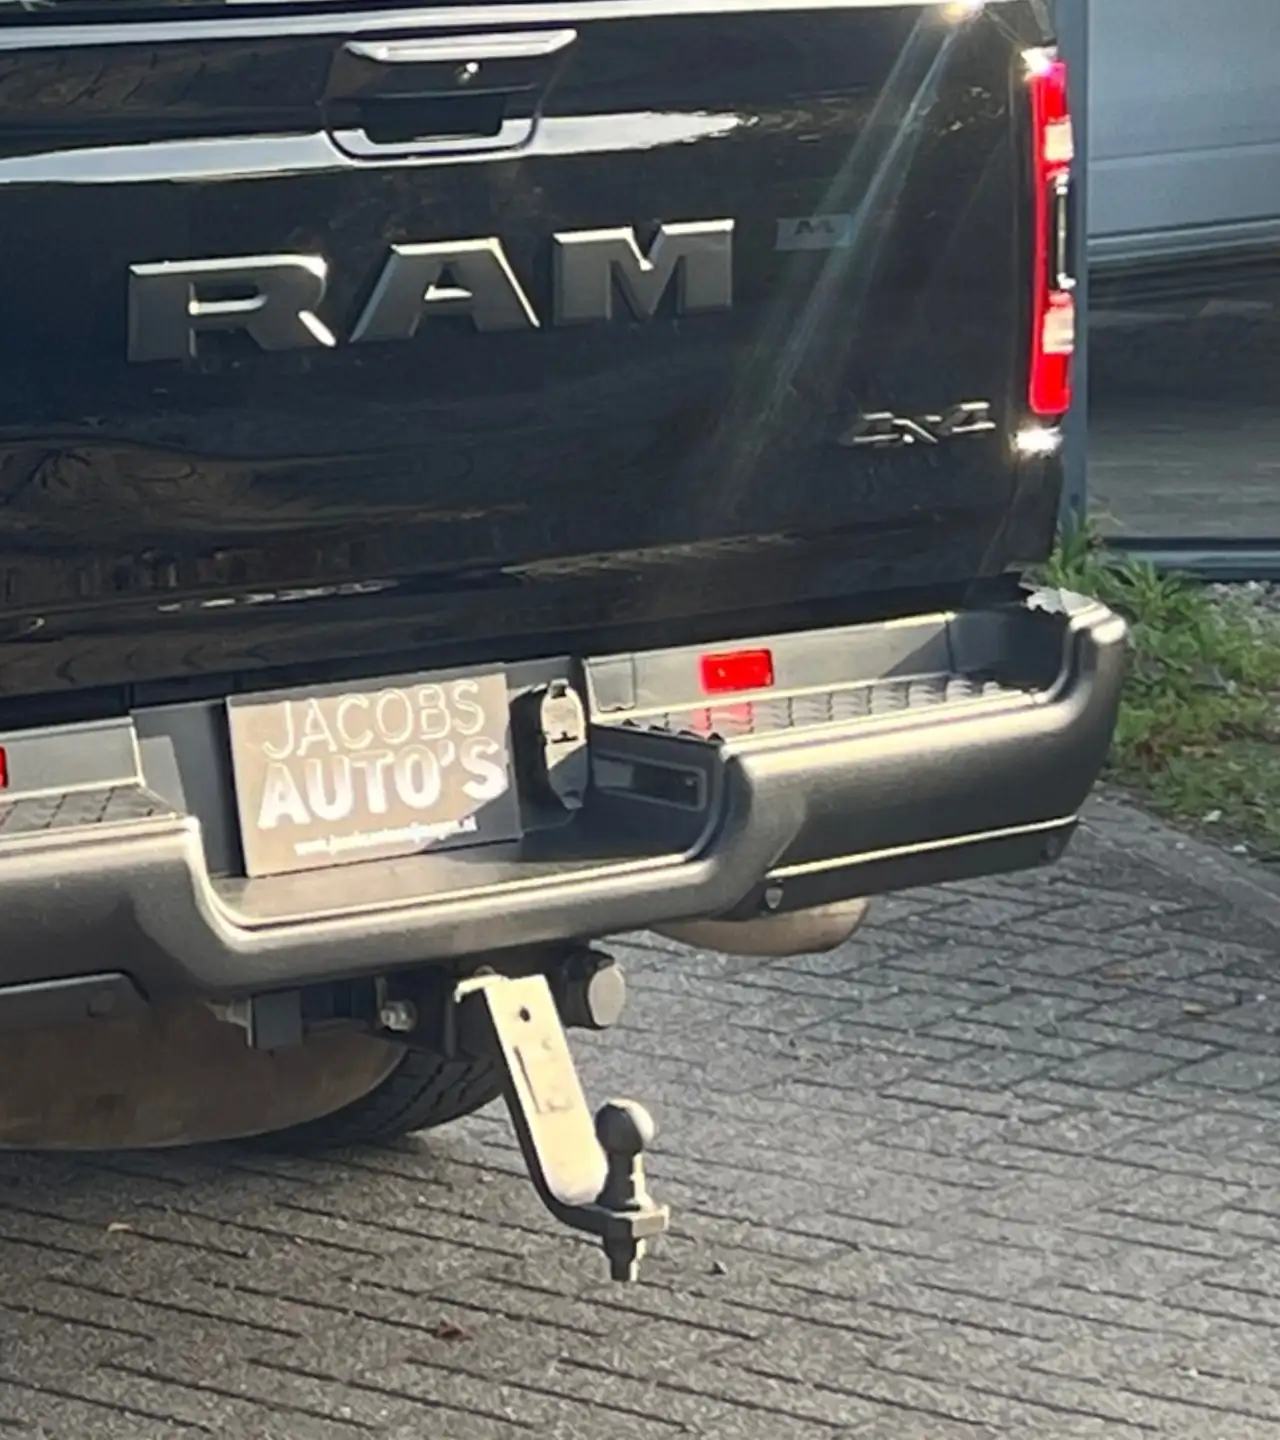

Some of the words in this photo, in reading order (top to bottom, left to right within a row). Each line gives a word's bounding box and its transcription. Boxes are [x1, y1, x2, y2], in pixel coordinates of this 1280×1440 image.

[127, 218, 736, 362] RAM
[262, 679, 486, 759] JACOBS
[256, 736, 510, 830] AUTO'S
